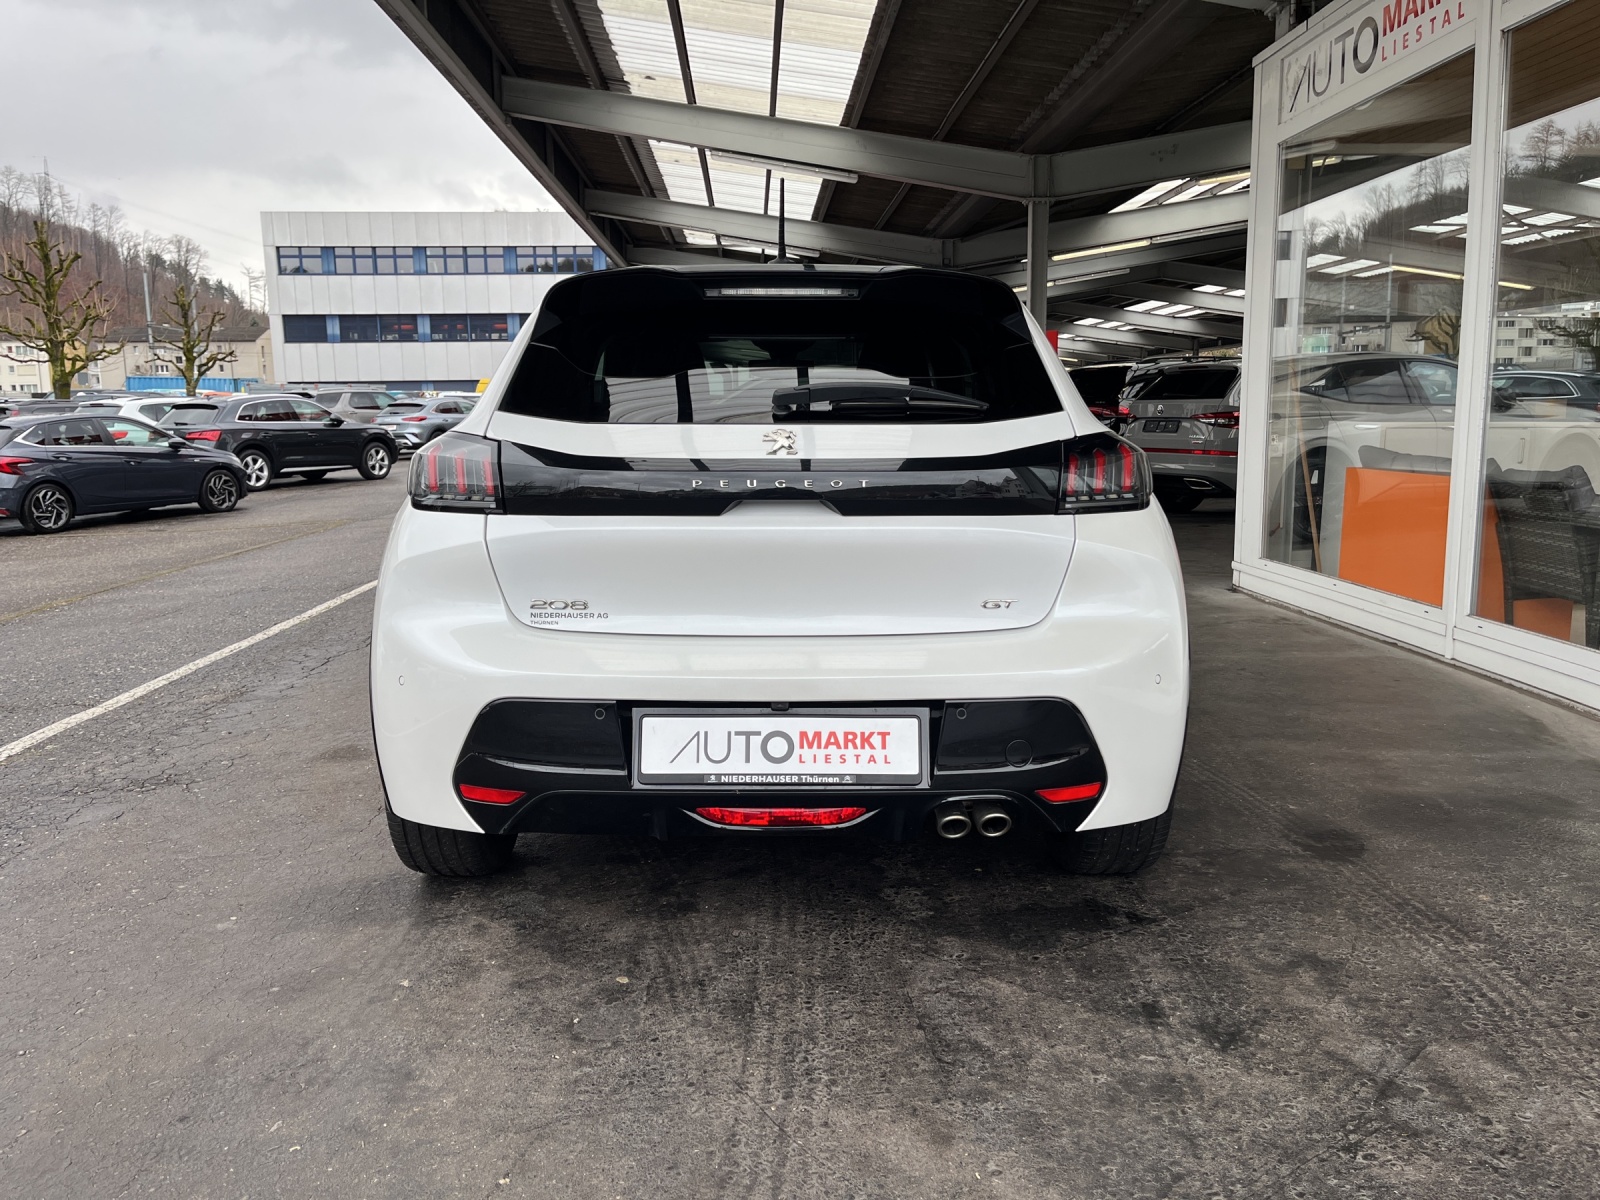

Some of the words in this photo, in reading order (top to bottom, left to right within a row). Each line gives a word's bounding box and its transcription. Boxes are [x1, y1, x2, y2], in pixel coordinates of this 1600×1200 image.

[1381, 2, 1465, 62] LIESTAL
[1289, 16, 1379, 113] AUTO
[692, 479, 869, 488] PEUGEOT
[529, 599, 589, 610] 208
[981, 599, 1019, 609] GT
[669, 730, 795, 764] AUTO
[799, 731, 891, 750] MARKT
[799, 754, 891, 764] LIESTAL
[721, 775, 799, 783] NIEDERHAUSER
[801, 775, 840, 783] Thürnen
